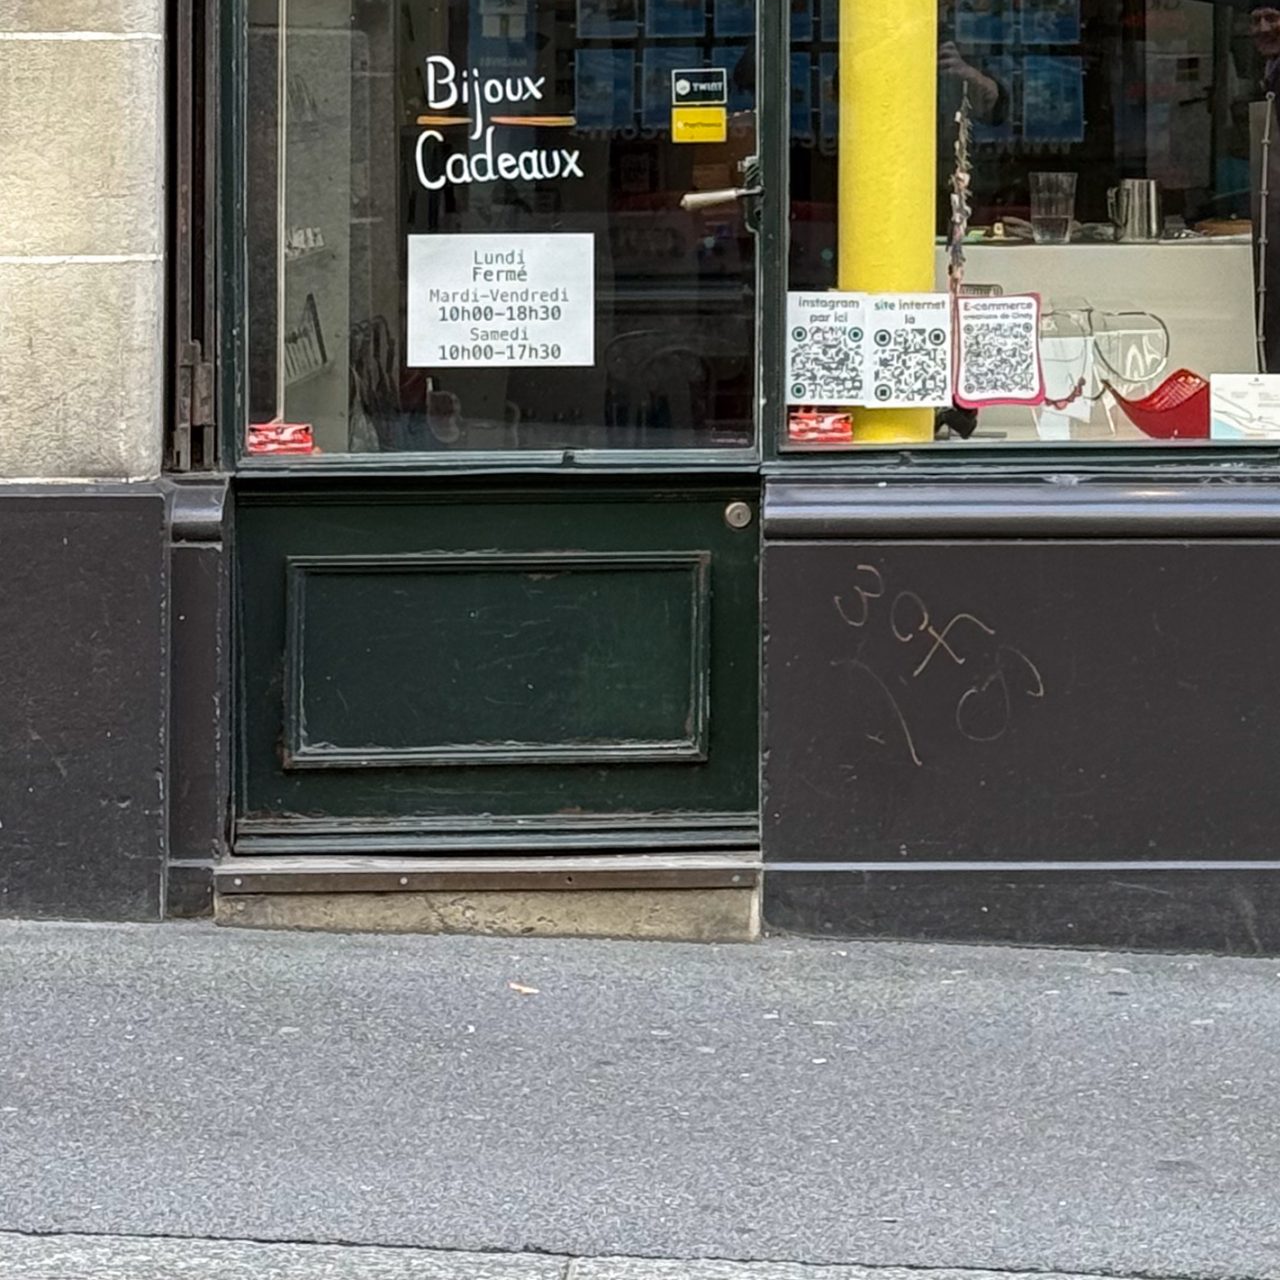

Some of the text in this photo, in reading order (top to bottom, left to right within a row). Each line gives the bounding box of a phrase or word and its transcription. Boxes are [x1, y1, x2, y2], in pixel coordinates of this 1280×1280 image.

[426, 55, 545, 140] Bijoux
[415, 128, 584, 190] Cadeaux
[474, 250, 525, 265] Lundi
[472, 266, 528, 282] Fermé
[429, 288, 569, 302] Mardi-Vendredi
[798, 297, 860, 310] instagram
[874, 299, 946, 311] site internet
[438, 305, 562, 322] 10h00-18h30
[809, 312, 848, 324] par ici
[470, 327, 529, 341] Samedi
[438, 344, 562, 361] 10h00-17h30
